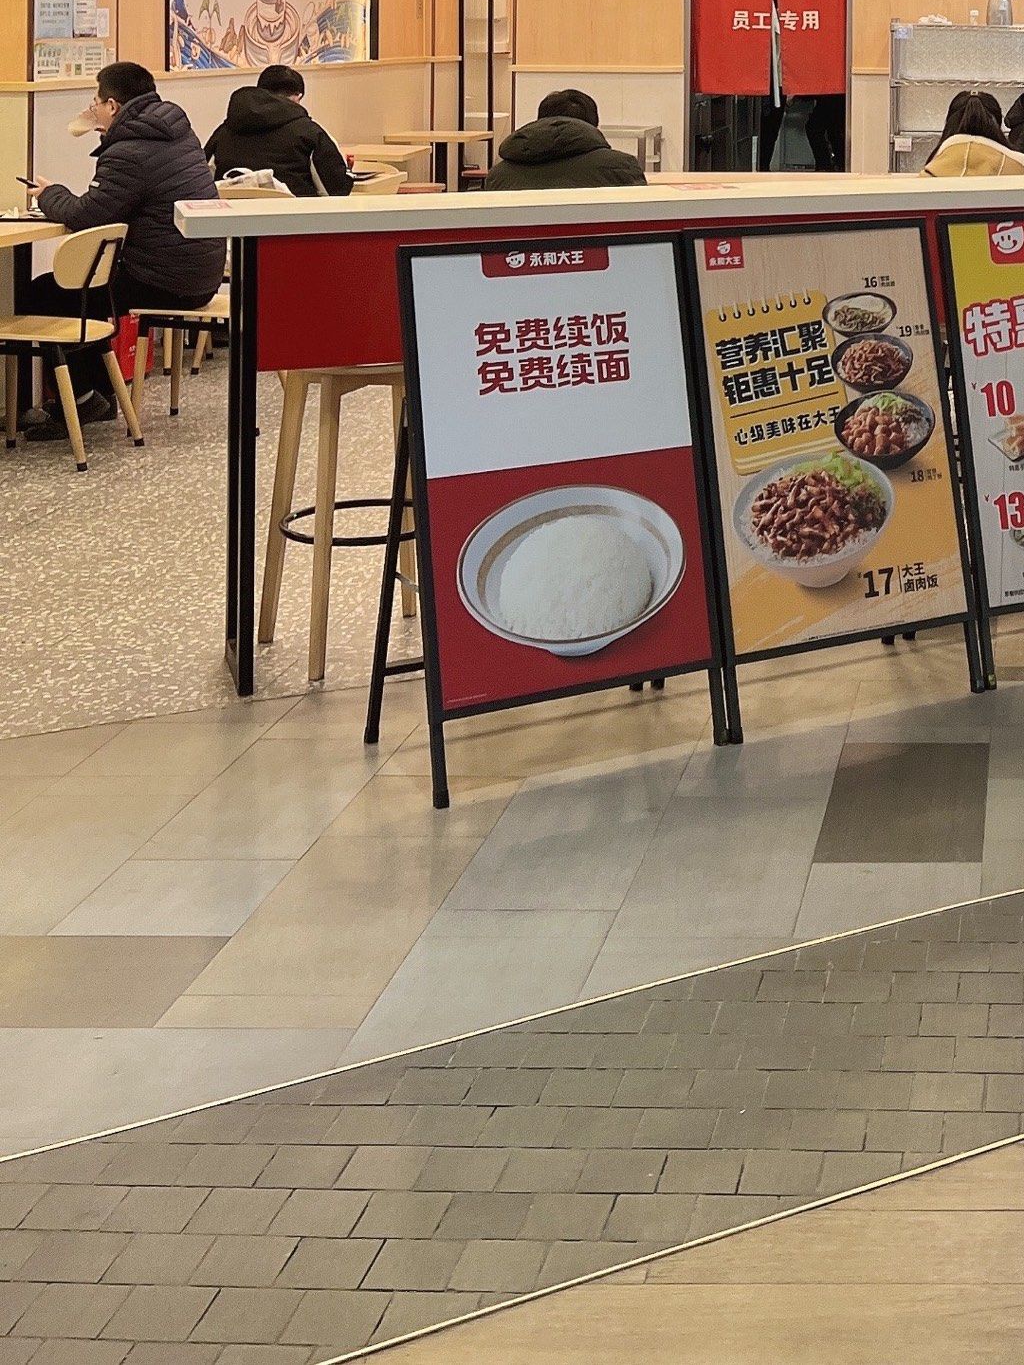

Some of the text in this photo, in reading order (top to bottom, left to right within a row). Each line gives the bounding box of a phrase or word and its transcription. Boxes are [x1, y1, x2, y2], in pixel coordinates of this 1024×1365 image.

[732, 9, 820, 32] 员工专用
[529, 249, 585, 268] 永和大王
[709, 255, 742, 267] 永和大王
[474, 310, 630, 357] 免费续饭
[714, 319, 829, 371] 营养汇聚
[477, 348, 631, 396] 免费续面
[721, 353, 836, 407] 钜惠十足
[902, 562, 926, 578] 大王
[903, 574, 939, 594] 卤肉饭
